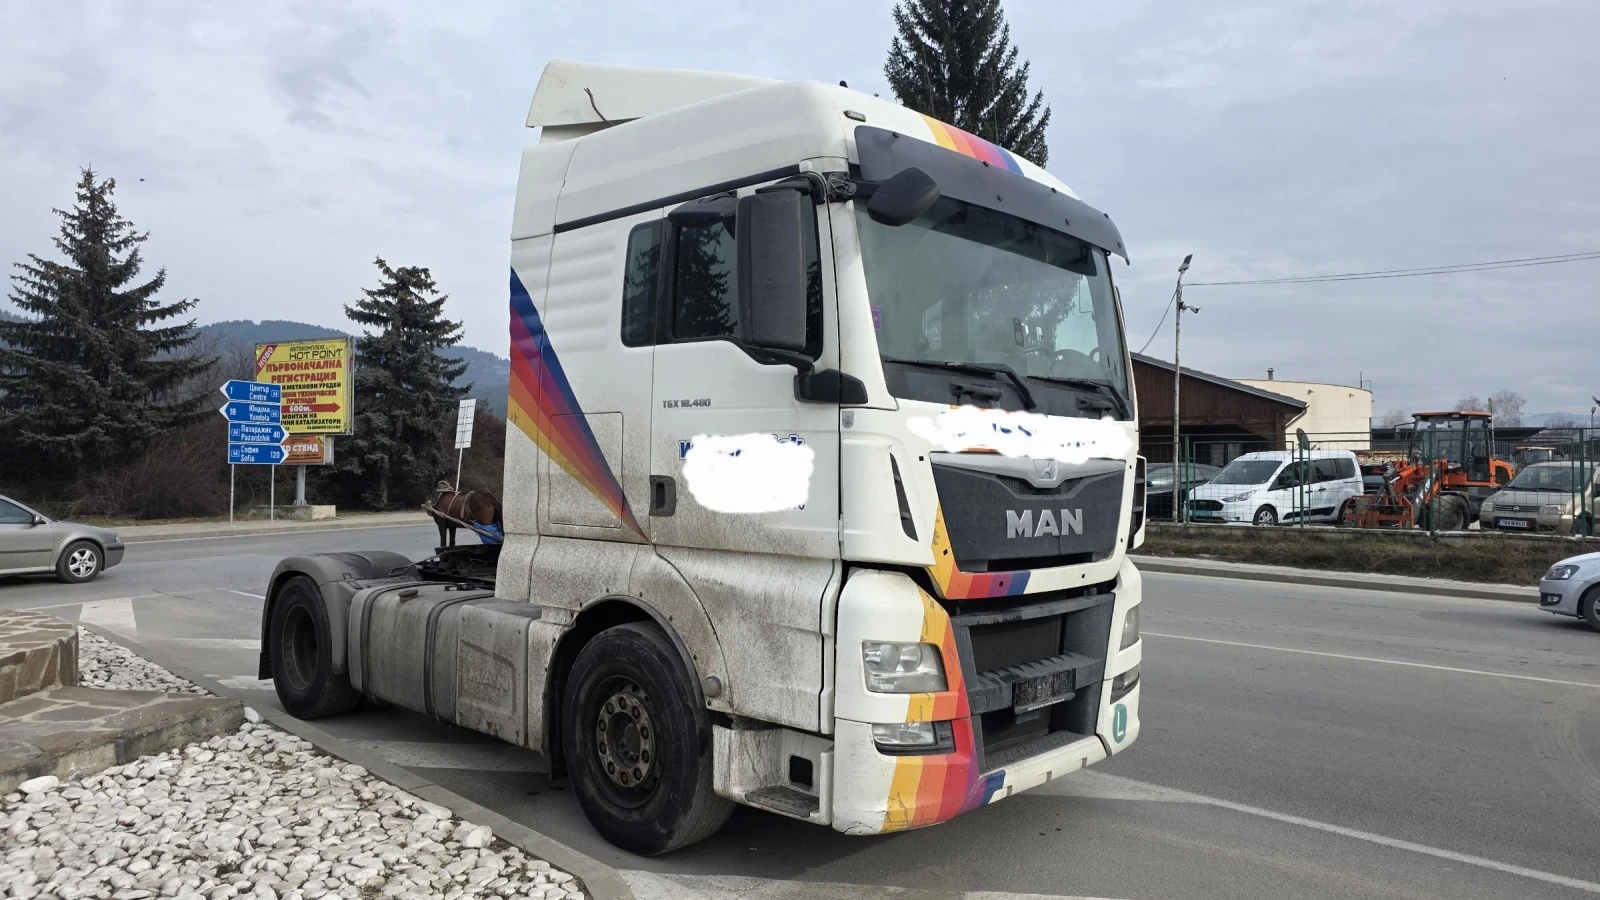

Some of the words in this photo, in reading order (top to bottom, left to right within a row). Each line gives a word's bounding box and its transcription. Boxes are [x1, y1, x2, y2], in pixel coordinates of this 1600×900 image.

[258, 346, 274, 368] НОВО
[290, 352, 310, 360] HOT
[312, 349, 343, 359] POINT
[266, 359, 342, 372] ПЪРВОНАЧАЛНА
[271, 372, 337, 383] РЕГИСТРАЦИЯ
[250, 384, 270, 394] Център
[250, 392, 268, 400] Centre
[249, 413, 270, 421] Yundola
[241, 425, 272, 434] Пазарджик
[241, 434, 270, 442] Pazardzhik
[292, 444, 318, 452] СТЕНД
[240, 454, 254, 462] Sofia
[270, 450, 280, 458] 120
[1006, 508, 1083, 538] MAN
[1116, 711, 1124, 738] L
